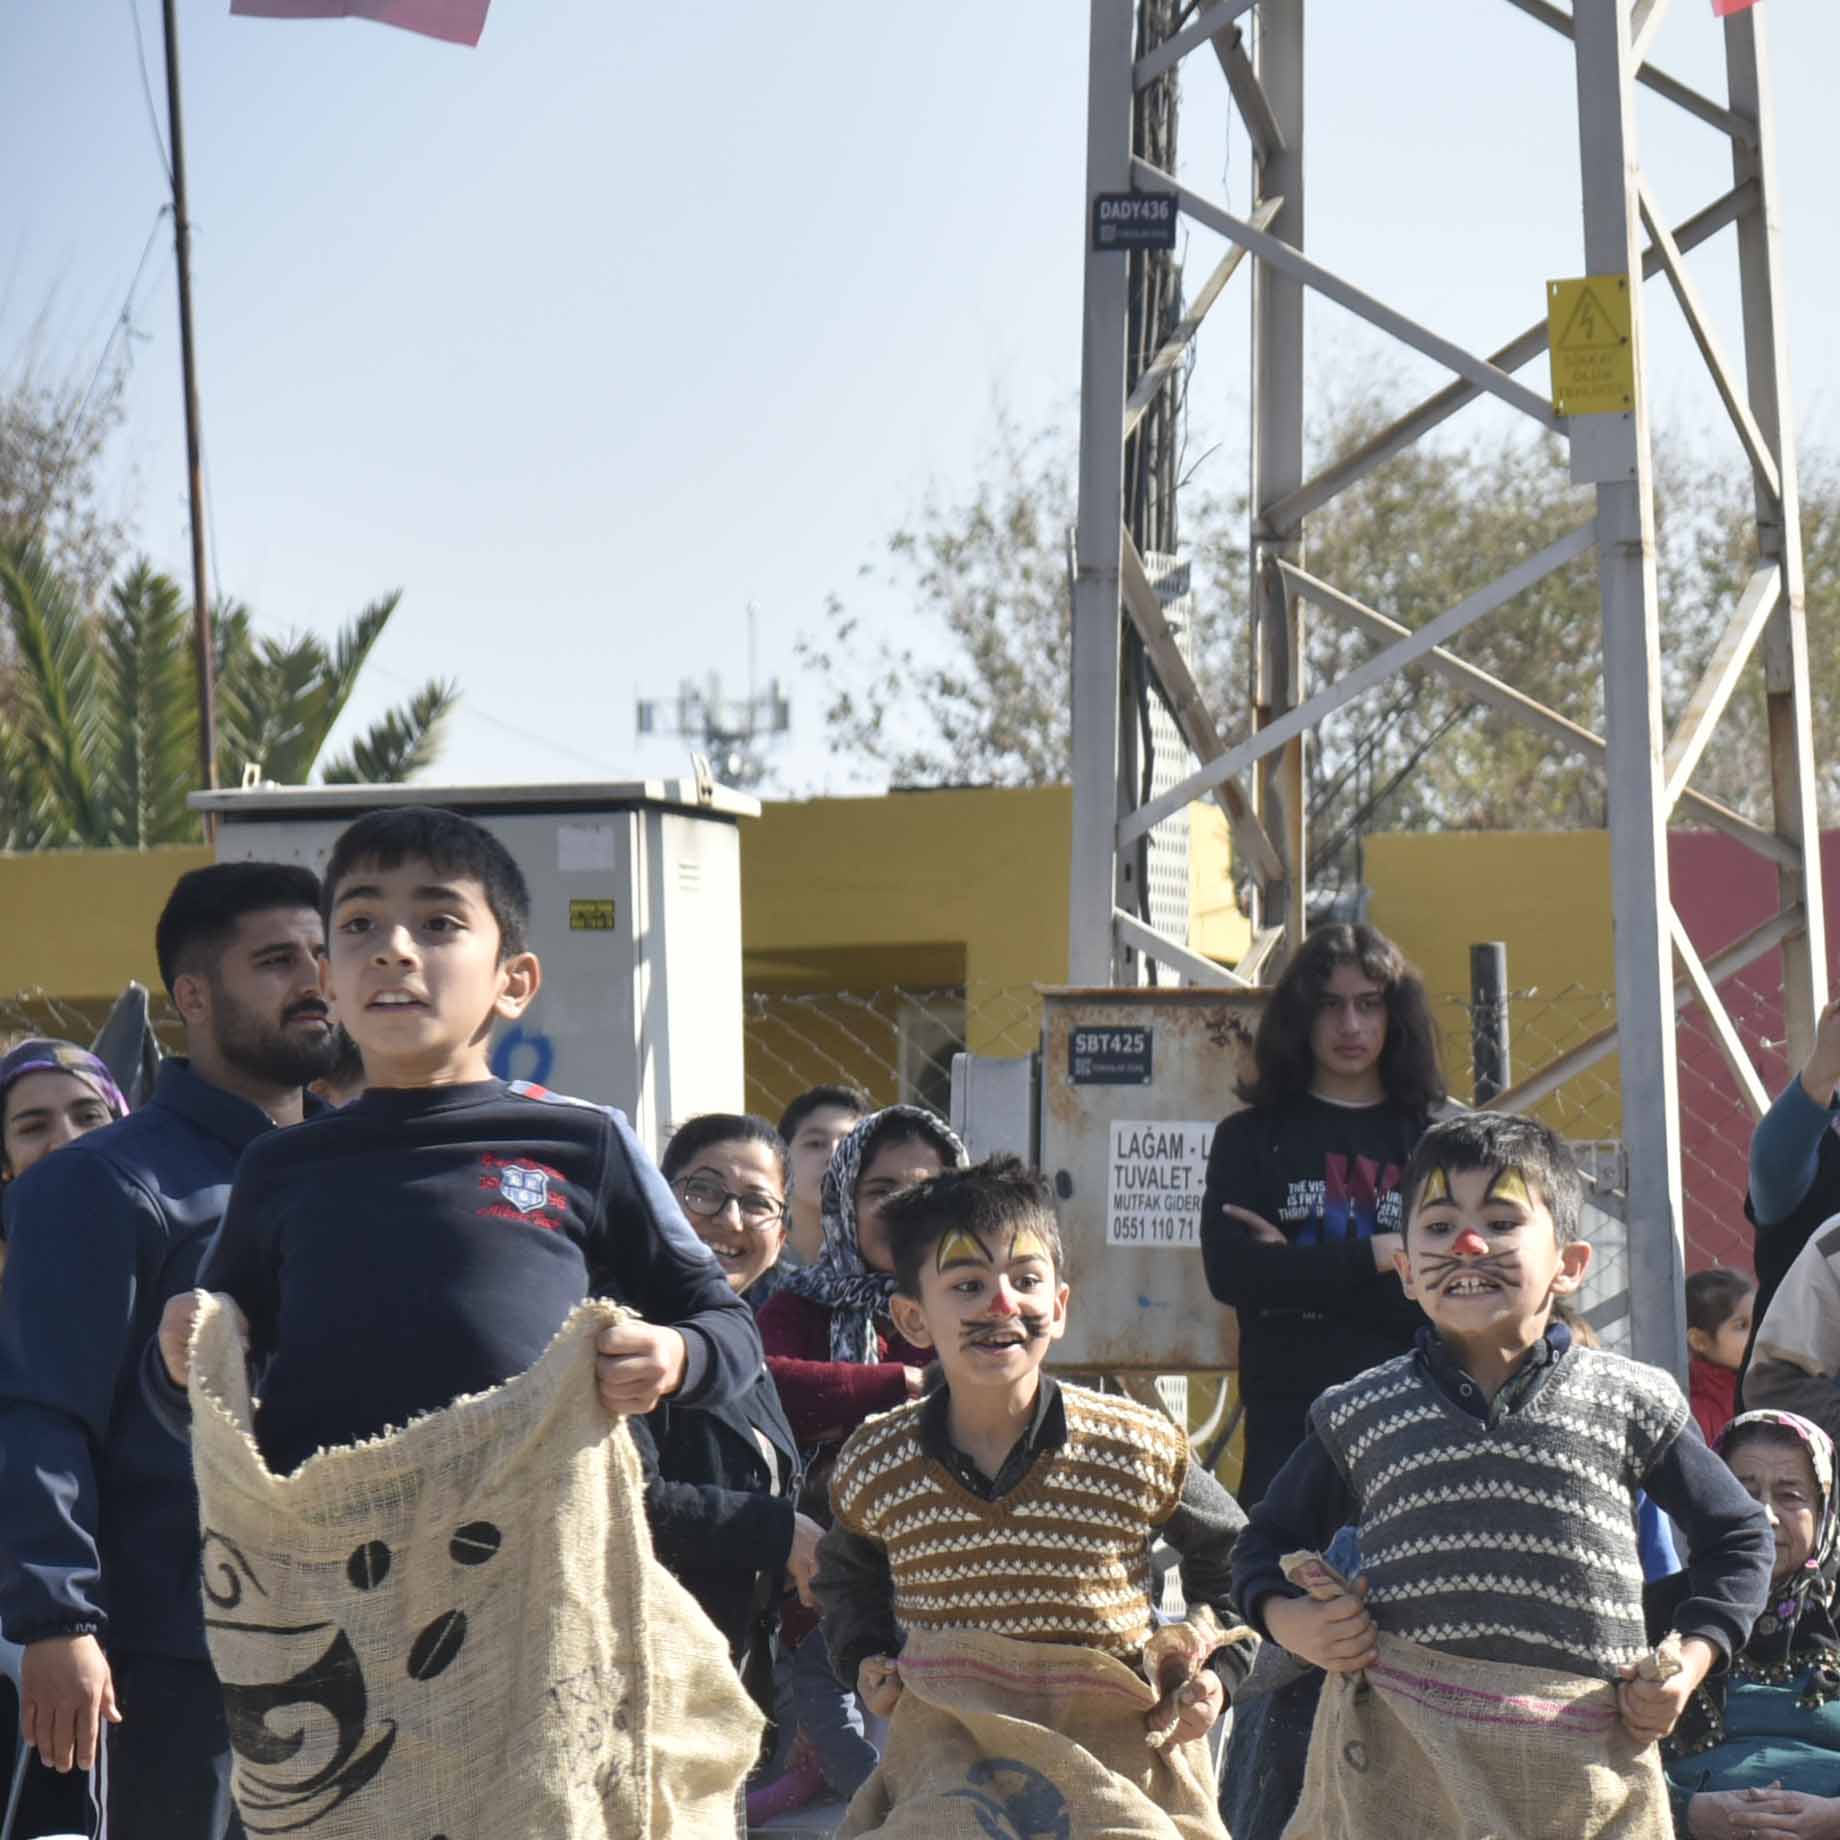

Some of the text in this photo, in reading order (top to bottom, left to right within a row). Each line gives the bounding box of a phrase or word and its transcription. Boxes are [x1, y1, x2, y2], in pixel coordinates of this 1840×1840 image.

[1100, 200, 1169, 219] DADY436
[1074, 1033, 1145, 1054] SBT425
[1117, 1126, 1184, 1160] LAĞAM
[1114, 1165, 1192, 1190] TUVALET
[1113, 1194, 1160, 1212] MUTFAK
[1113, 1217, 1145, 1239] 0551
[1152, 1217, 1174, 1239] 110
